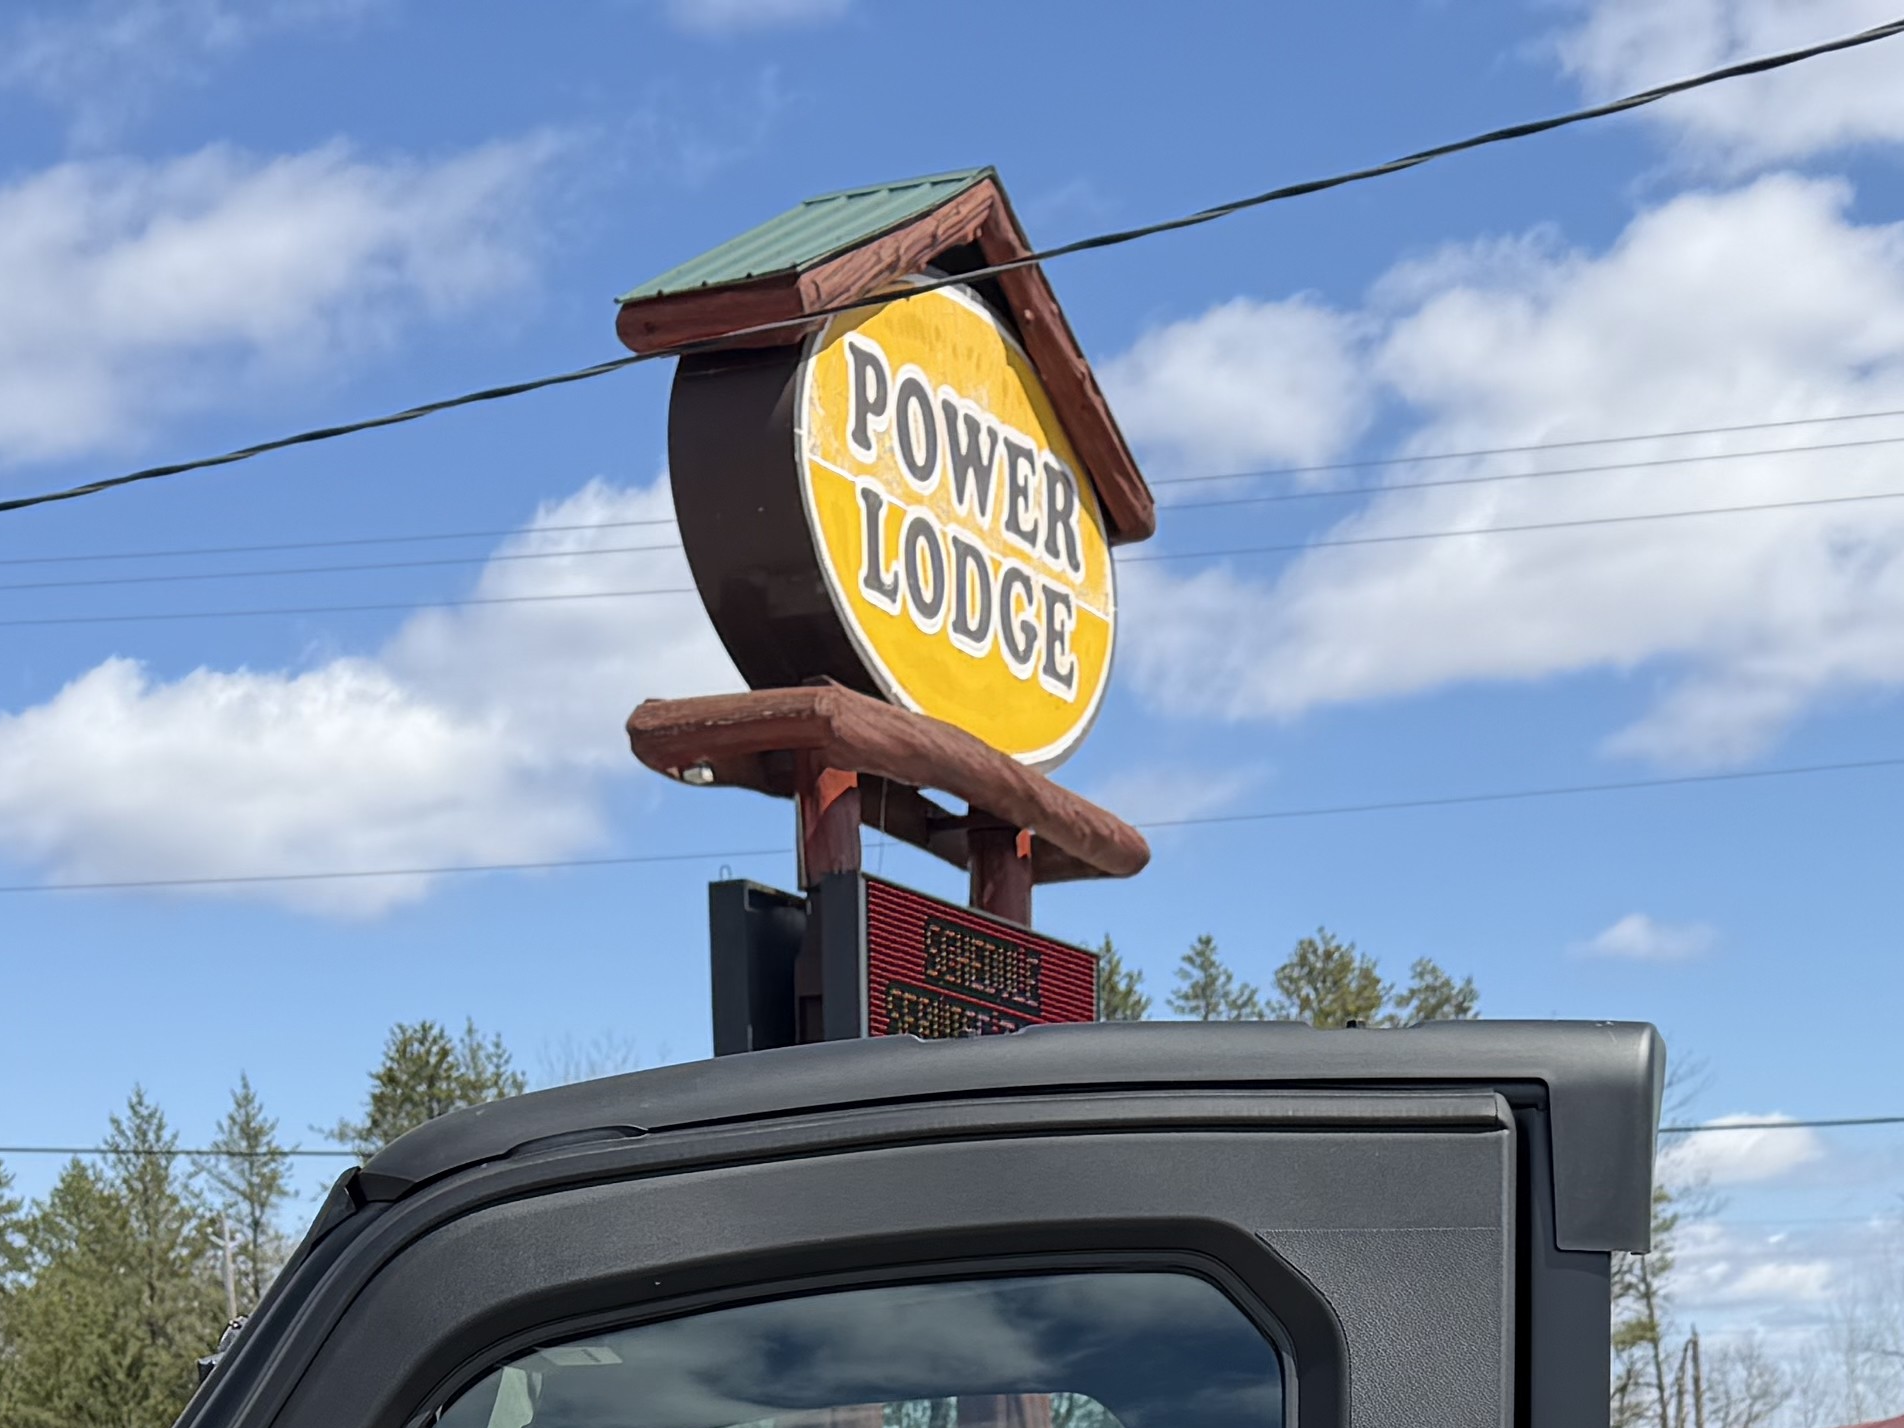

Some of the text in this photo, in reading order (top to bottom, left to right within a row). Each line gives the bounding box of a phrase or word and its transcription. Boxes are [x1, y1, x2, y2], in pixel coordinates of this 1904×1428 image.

[846, 337, 1082, 577] POWER
[856, 486, 1077, 691] LODGE
[925, 923, 1040, 1008] SCHEDULE
